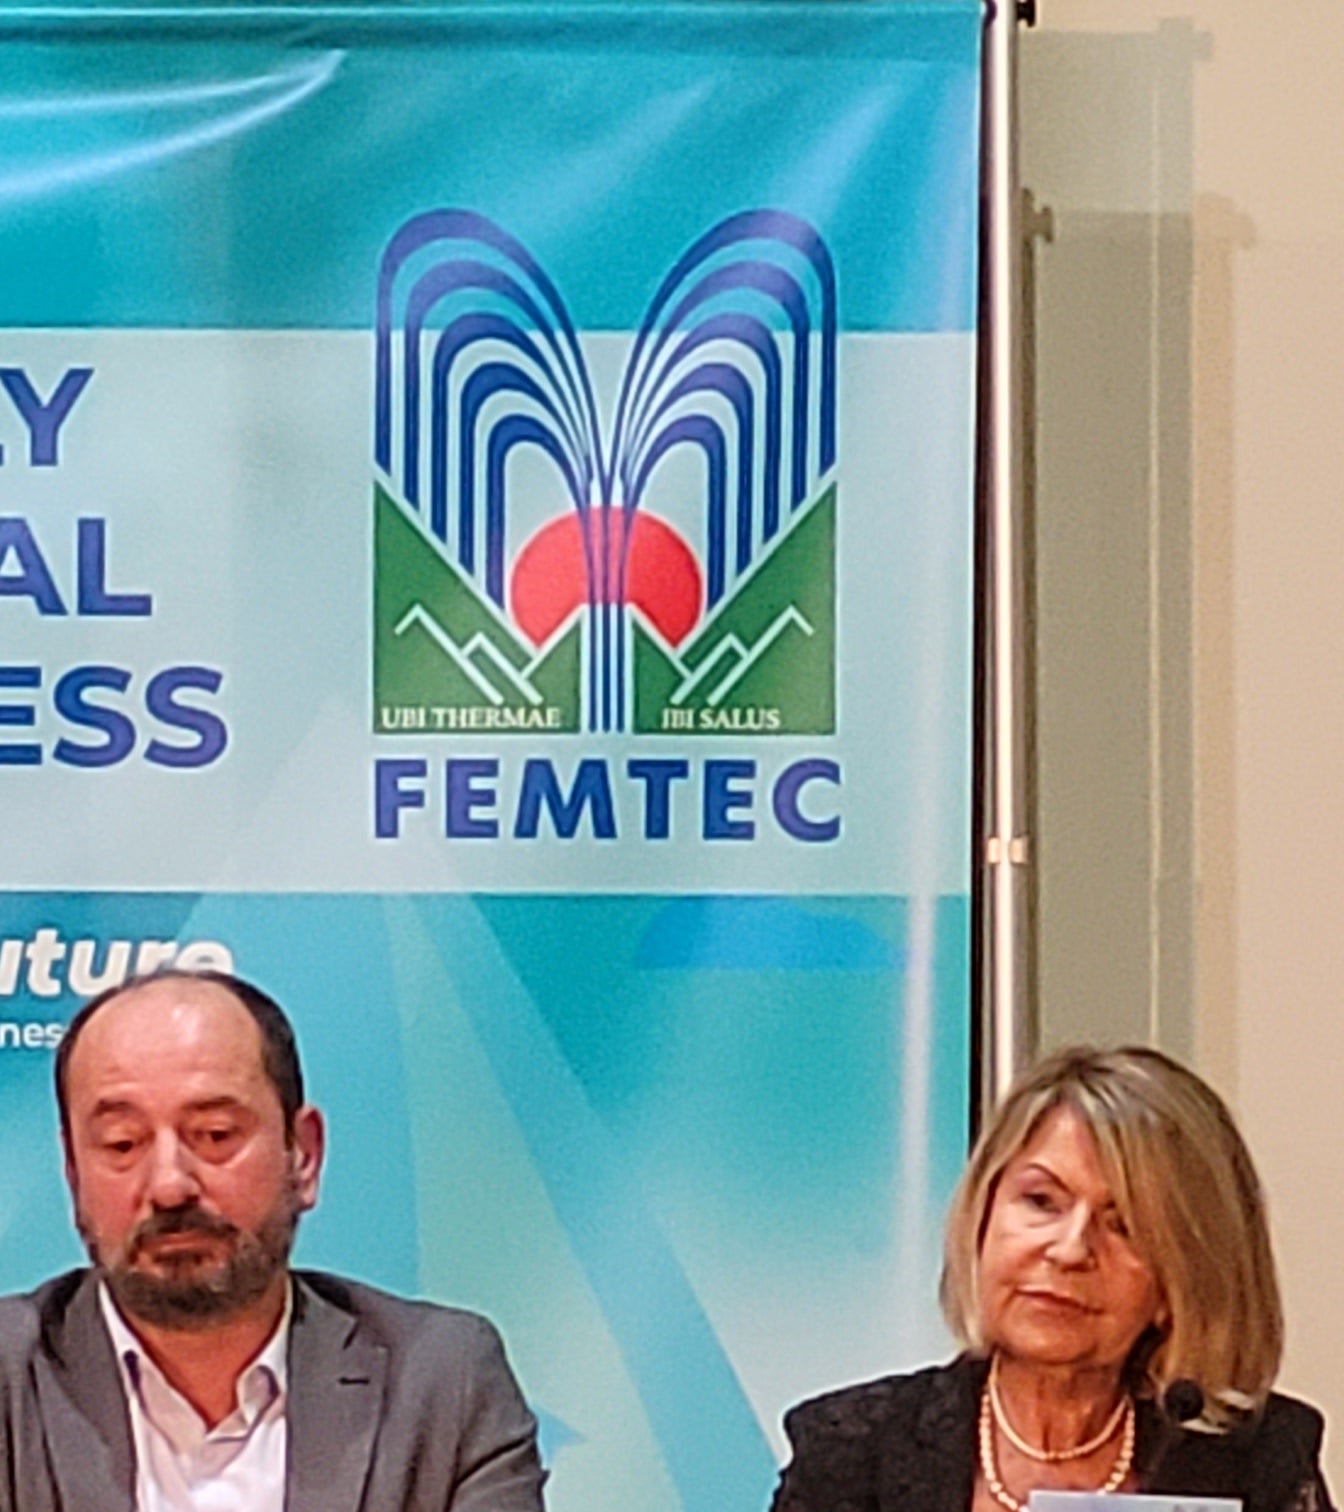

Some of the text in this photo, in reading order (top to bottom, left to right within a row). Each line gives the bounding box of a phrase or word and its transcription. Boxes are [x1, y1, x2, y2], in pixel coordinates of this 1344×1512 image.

[381, 708, 561, 728] UBI THERMAE
[699, 708, 780, 729] SALUS
[375, 759, 841, 842] FEMTEC
